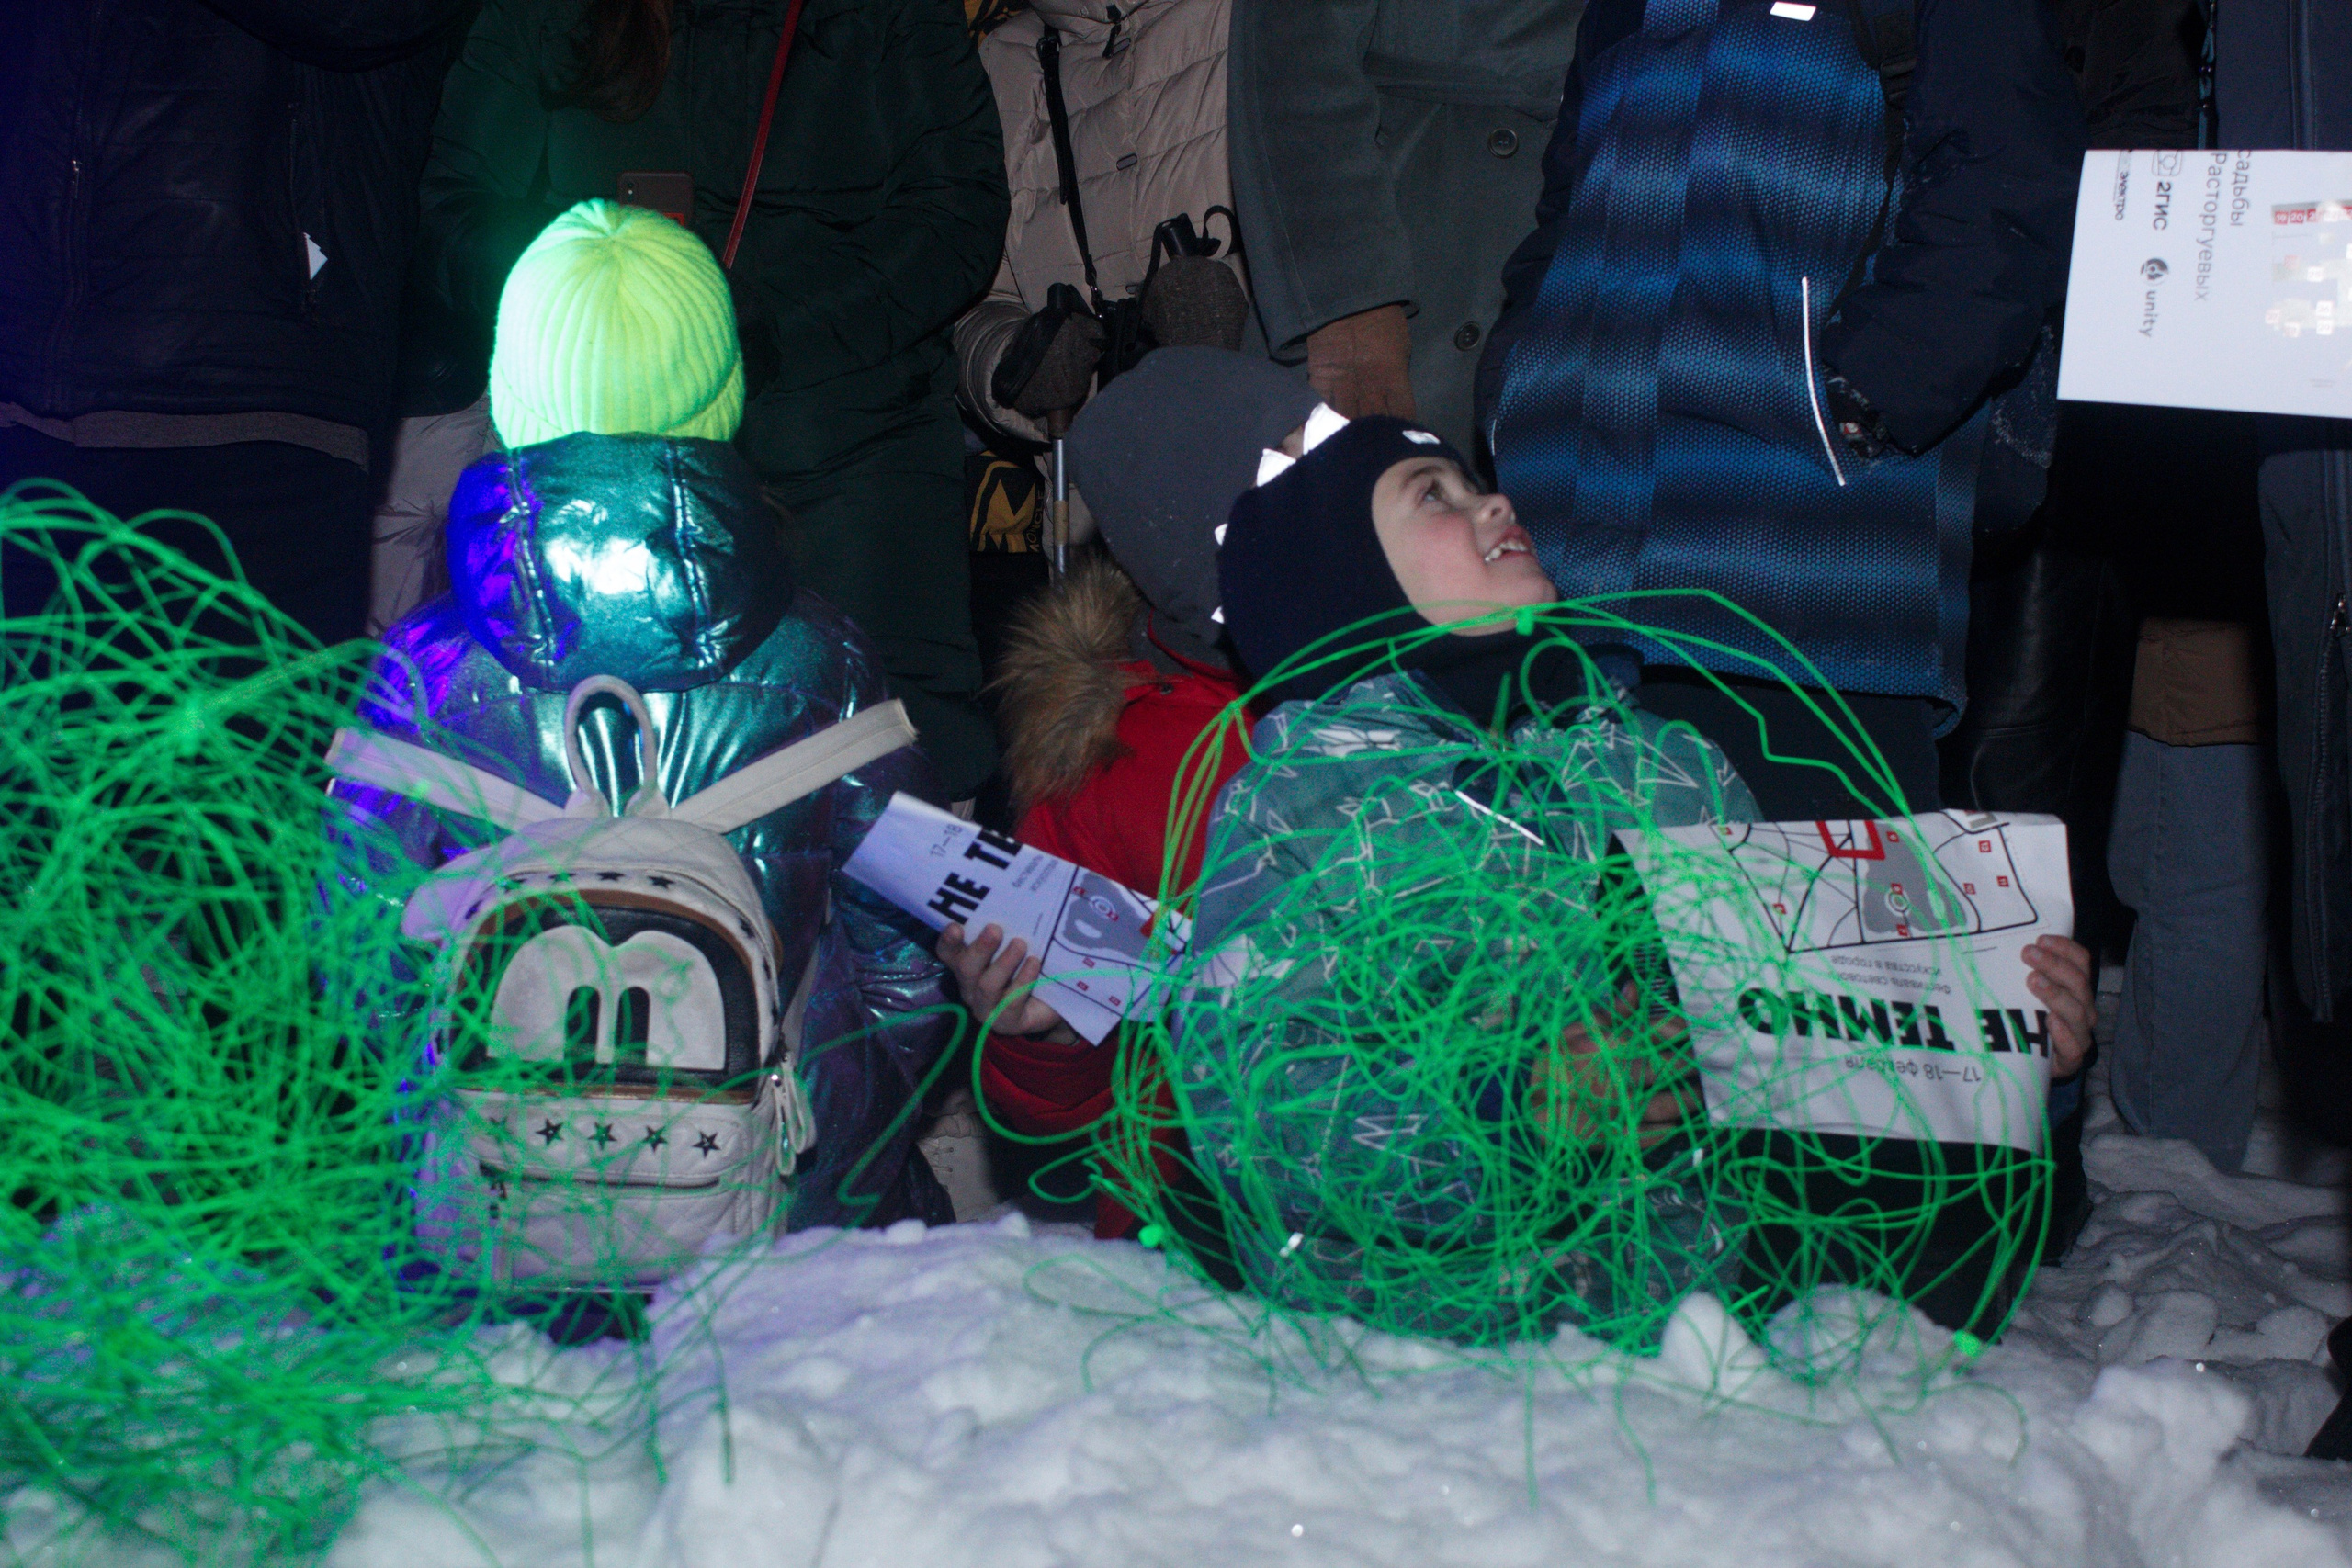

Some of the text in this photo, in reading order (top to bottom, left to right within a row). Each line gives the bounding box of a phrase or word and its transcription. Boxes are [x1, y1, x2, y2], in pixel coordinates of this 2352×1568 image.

[2152, 181, 2172, 231] 2ГИС
[2230, 150, 2252, 227] садьбы
[2194, 151, 2228, 302] Расторгуевых
[2138, 290, 2159, 338] unity
[926, 872, 991, 925] НЕ
[1738, 987, 2049, 1057] НЕ ТЕМНО
[1923, 1064, 1982, 1082] 17—18
